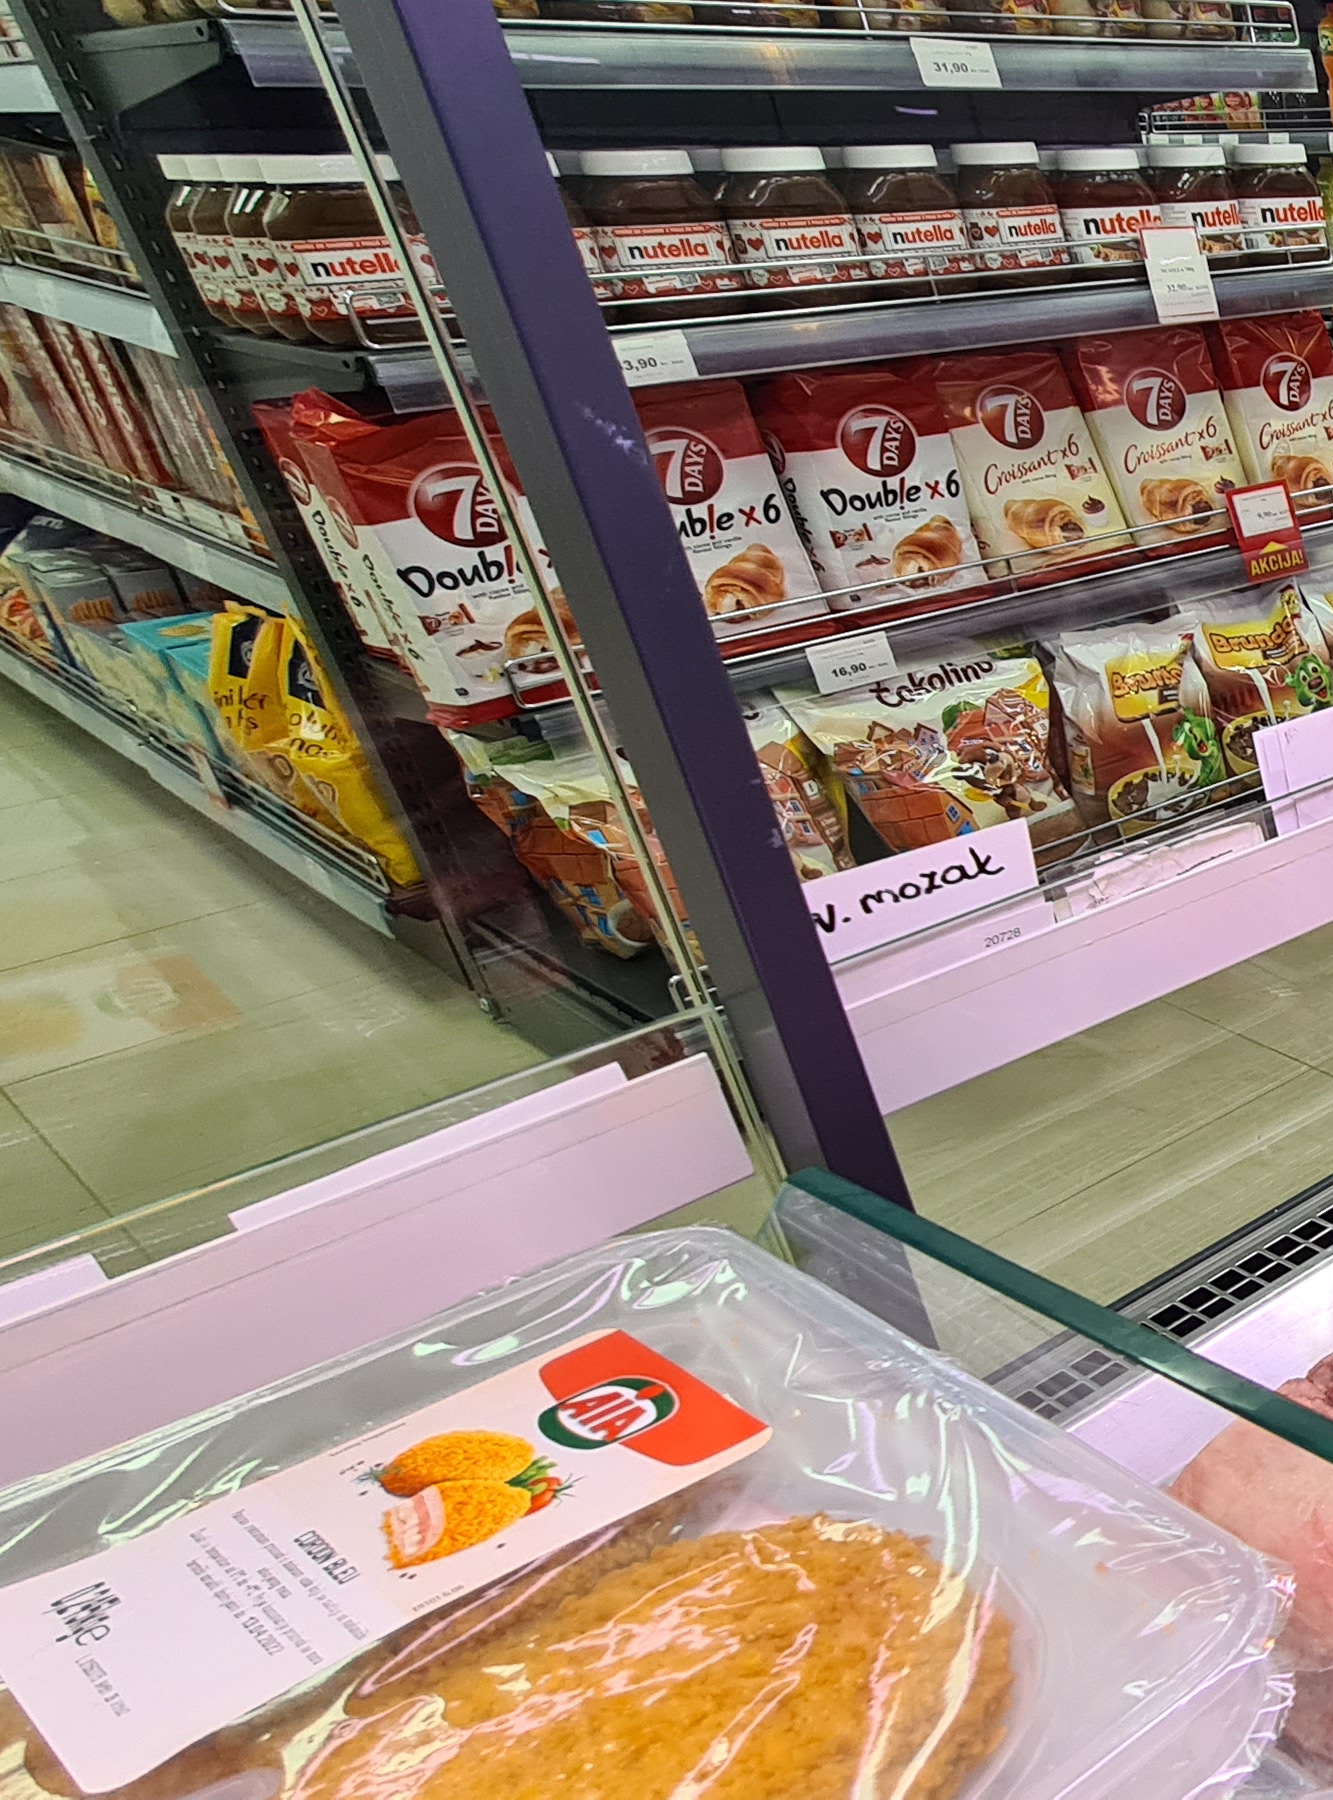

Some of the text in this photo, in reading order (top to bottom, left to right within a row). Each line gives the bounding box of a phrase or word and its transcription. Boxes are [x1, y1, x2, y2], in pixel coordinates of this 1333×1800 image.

[933, 61, 969, 74] 31,90
[1007, 218, 1057, 238] nutella
[1191, 203, 1240, 229] nutell
[627, 238, 709, 261] nutella
[774, 230, 844, 251] nutella
[891, 224, 954, 245] nutella
[311, 251, 401, 278] nutell
[620, 357, 657, 371] 3,90
[1270, 362, 1305, 406] 7 DAYS
[985, 392, 1032, 443] 7 DAYS
[1132, 377, 1176, 426] 7 DAYS
[851, 416, 904, 471] 7 DAYS
[1124, 415, 1217, 475] Croissant x6
[1259, 413, 1319, 450] Croissant
[685, 441, 707, 493] DAYS
[984, 433, 1080, 495] Croissant x6
[925, 469, 960, 500] x6
[426, 475, 499, 540] 7 DAY
[738, 493, 781, 527] x6
[1250, 549, 1304, 576] AKCIJA!
[831, 662, 867, 678] 16,90
[859, 847, 1005, 914] mozak
[983, 927, 1022, 948] 20728
[558, 1391, 647, 1442] AIA
